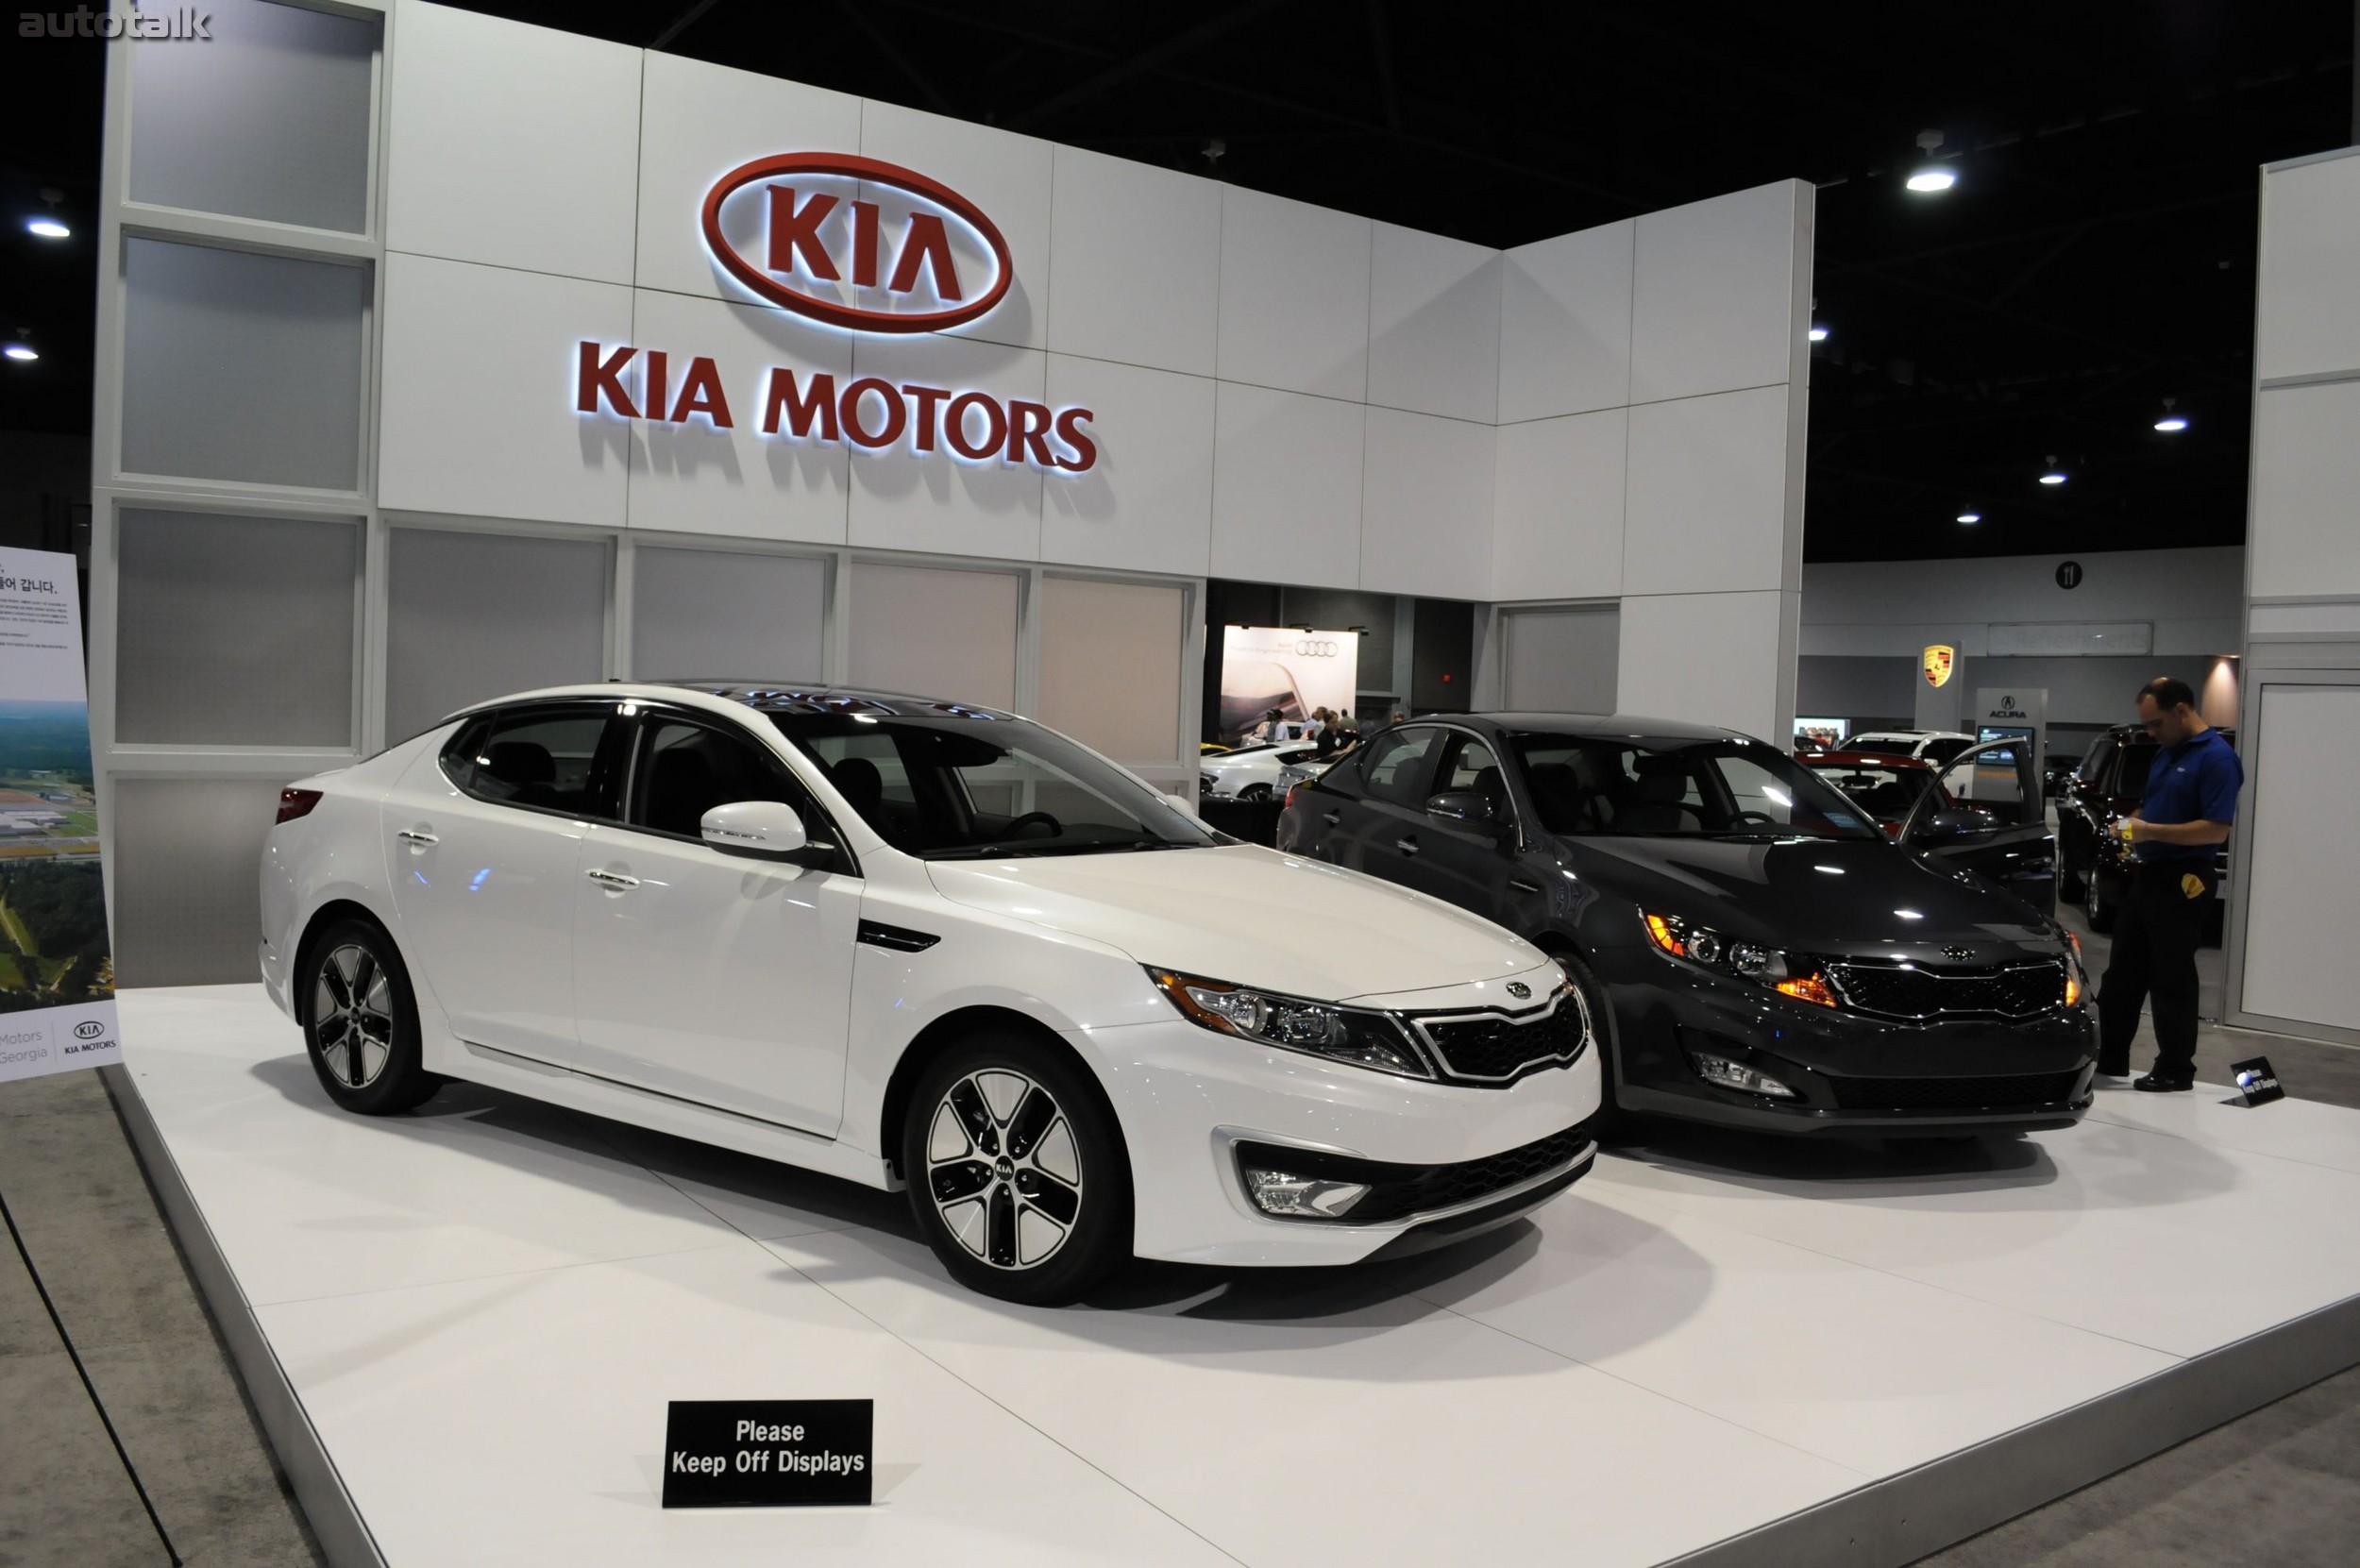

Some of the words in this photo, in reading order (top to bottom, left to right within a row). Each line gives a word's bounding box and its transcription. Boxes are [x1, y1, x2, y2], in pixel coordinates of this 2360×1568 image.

[767, 183, 963, 302] KIA
[576, 340, 734, 429] KIA
[762, 367, 1098, 473] MOTORS
[20, 578, 58, 595] 갑니다.
[1989, 710, 2027, 718] ACURA
[78, 1024, 101, 1036] KIA
[0, 1047, 48, 1064] Georgia
[64, 1046, 79, 1054] KIA
[81, 1040, 116, 1052] MOTORS
[996, 1164, 1012, 1173] KIA
[735, 1419, 805, 1442] Please
[672, 1451, 727, 1477] Keep
[735, 1450, 770, 1473] Off
[778, 1450, 865, 1475] Displays
